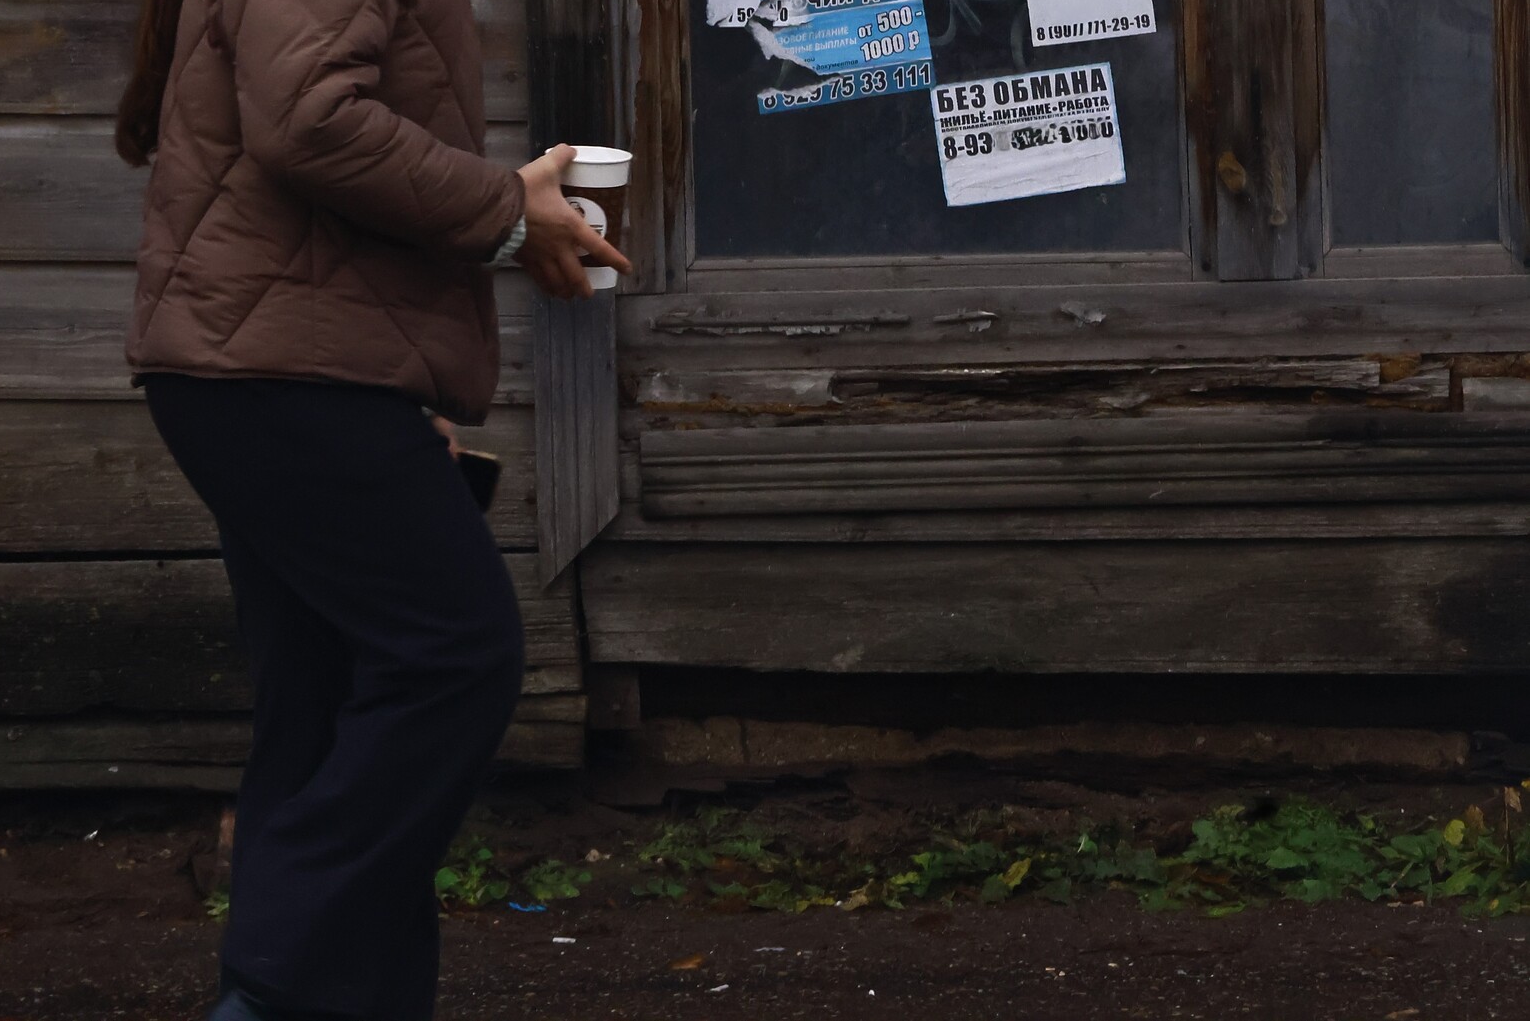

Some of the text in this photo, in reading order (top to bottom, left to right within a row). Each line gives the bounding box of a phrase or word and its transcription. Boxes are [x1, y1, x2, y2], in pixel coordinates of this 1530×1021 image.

[809, 26, 848, 39] ПИТАНИЕ
[858, 6, 912, 38] от 500
[815, 37, 857, 51] ВЫПЛАТЫ
[860, 30, 919, 62] 1000 р
[830, 62, 931, 99] 75 33 111
[937, 68, 1107, 113] БЕЗ ОБМАНА
